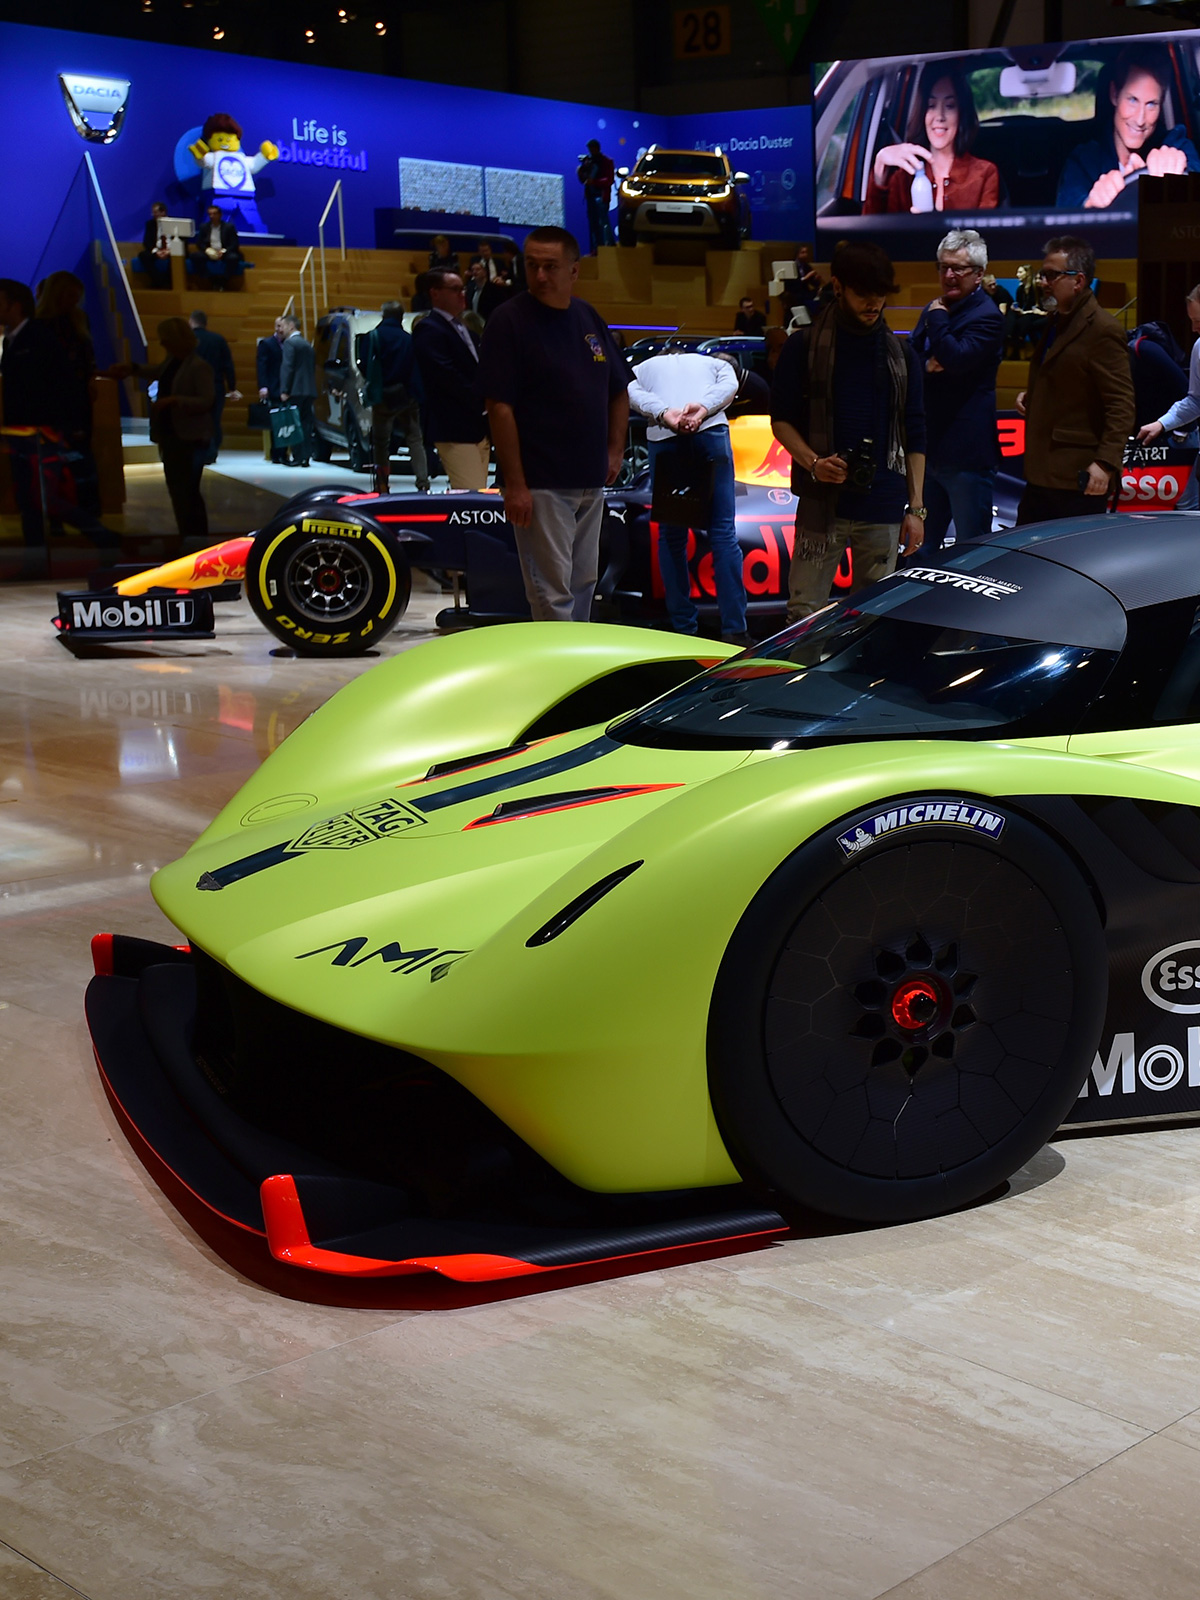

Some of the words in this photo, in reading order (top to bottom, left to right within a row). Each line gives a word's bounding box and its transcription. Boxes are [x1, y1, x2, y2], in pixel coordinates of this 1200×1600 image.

[683, 11, 722, 53] 28
[73, 85, 121, 98] DACIA
[293, 117, 329, 144] Life
[332, 124, 348, 146] is
[730, 138, 757, 152] Dacia
[759, 135, 794, 149] Duster
[277, 140, 368, 172] bluetiful
[302, 518, 363, 539] PIRELLI
[449, 509, 507, 525] ASTON
[72, 600, 162, 629] Mobil
[175, 601, 186, 624] 1
[275, 614, 352, 645] ZERO
[357, 802, 415, 833] TAG
[874, 804, 1001, 836] MICHELIN
